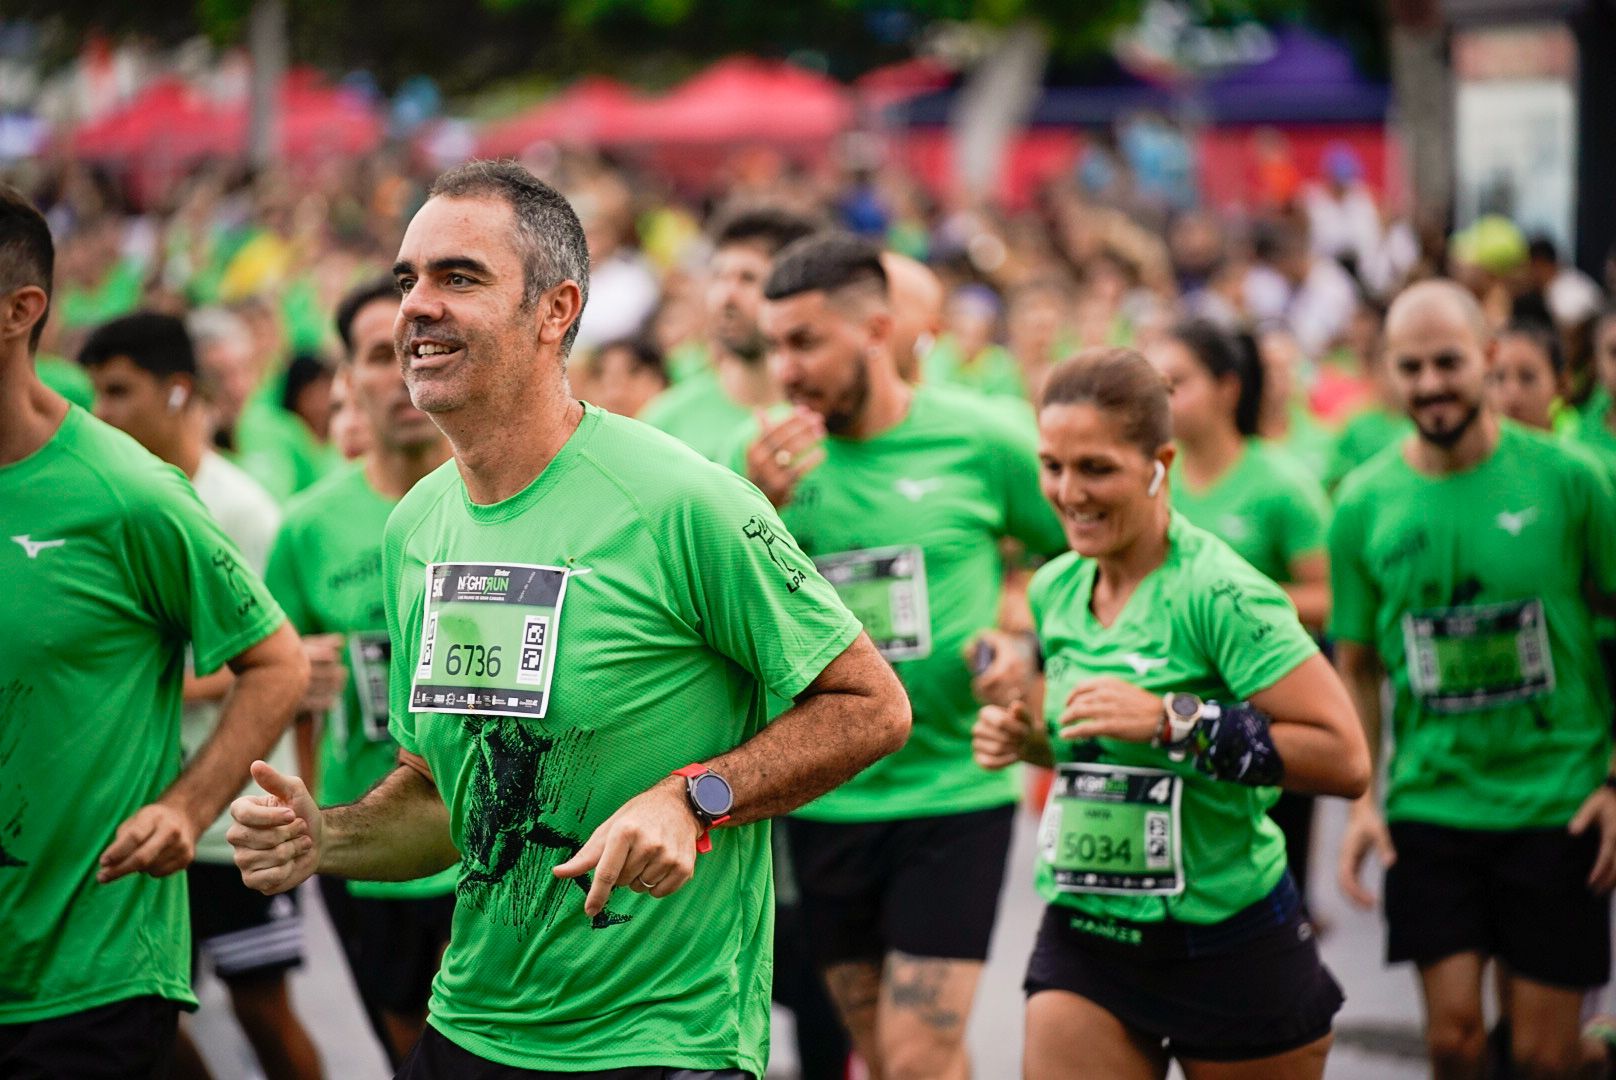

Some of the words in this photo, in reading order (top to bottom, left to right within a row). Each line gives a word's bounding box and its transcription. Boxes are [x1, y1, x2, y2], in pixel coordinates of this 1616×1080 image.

[432, 577, 446, 598] 5K
[786, 570, 807, 593] LPA
[446, 644, 502, 678] 6736
[1147, 776, 1171, 804] 4
[1063, 831, 1132, 864] 5034
